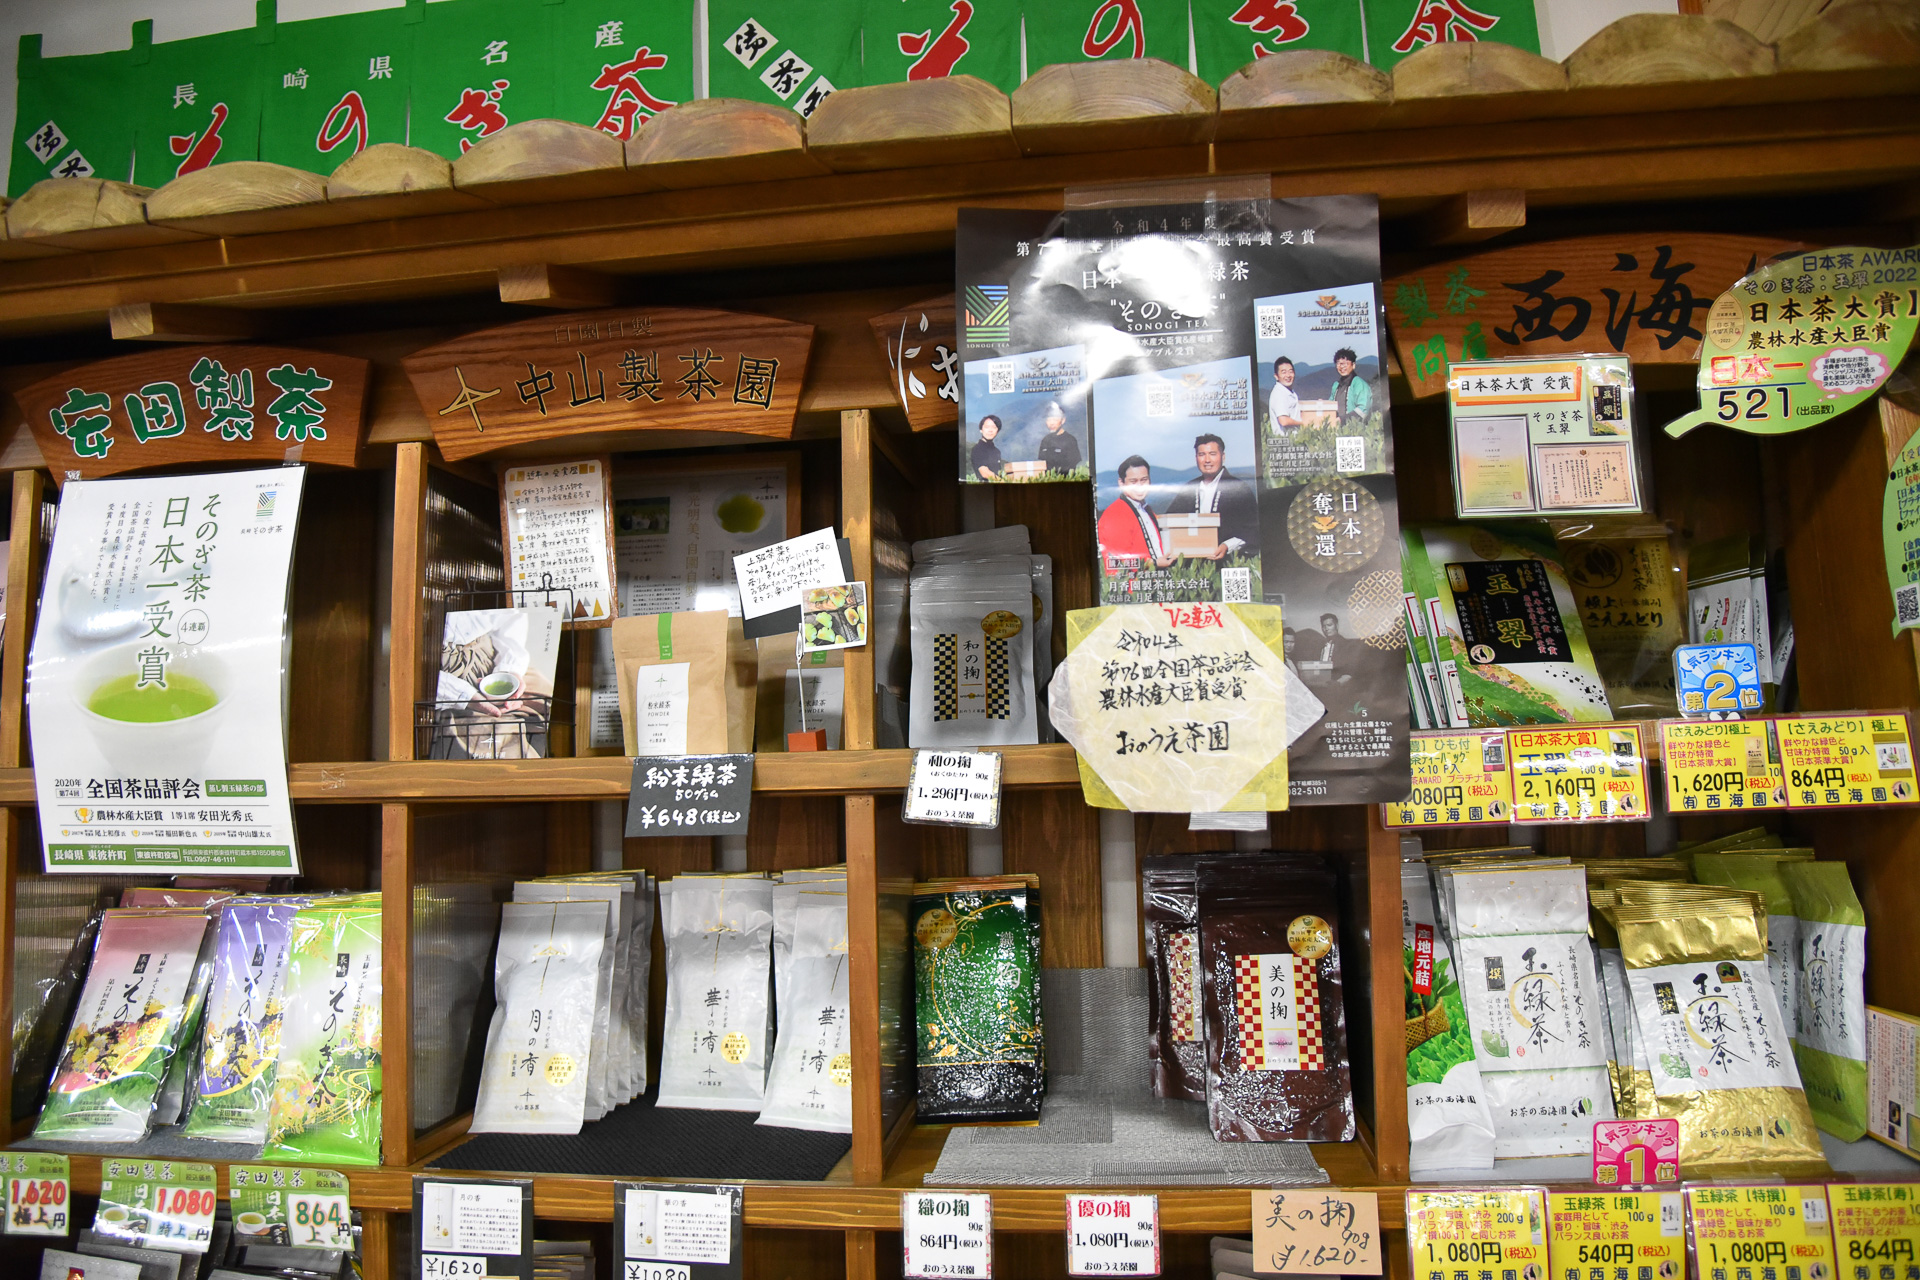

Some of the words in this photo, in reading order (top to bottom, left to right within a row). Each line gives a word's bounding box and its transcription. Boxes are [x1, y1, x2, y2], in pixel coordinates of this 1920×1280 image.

[1803, 253, 1854, 272] 日本茶
[1873, 267, 1917, 284] 2022
[1127, 322, 1179, 331] SONOGI
[1186, 320, 1209, 328] TEA
[1747, 322, 1891, 350] 農林水産大臣賞
[1710, 353, 1804, 384] 日本一
[514, 348, 780, 416] 中山製茶園
[1460, 376, 1534, 392] 日本茶大賞
[1543, 375, 1572, 390] 受賞
[50, 357, 333, 459] 安田製茶
[1718, 386, 1790, 421] 521
[1796, 404, 1835, 416] (出品数)
[1532, 409, 1584, 423] そのぎ茶
[1546, 423, 1571, 435] 玉翠
[253, 525, 283, 534] そのぎ茶
[1312, 492, 1337, 557] 奪還
[1341, 492, 1363, 556] 日本一
[182, 493, 222, 603] そのぎ茶
[137, 496, 190, 688] 日本一受賞
[1108, 579, 1210, 592] 月香園製茶株式会社
[1163, 605, 1224, 629] V2達成
[1486, 573, 1534, 649] 玉翠
[1544, 597, 1562, 634] そのぎ茶
[1585, 611, 1664, 628] さえみどり
[1115, 629, 1184, 653] 令和4年
[963, 640, 980, 680] 和の掬
[1101, 651, 1264, 686] 第76回全国茶品評会
[1678, 648, 1757, 679] 人気ランキング
[1098, 677, 1248, 713] 農林水産大臣賞受賞
[1684, 673, 1760, 711] 第2位
[1361, 709, 1368, 717] 5
[1331, 728, 1387, 736] ように管理し、新鮮
[1668, 723, 1751, 738] 【さえみどり】極上
[1787, 720, 1865, 735] 【さえみどり】
[1871, 719, 1899, 732] 極上
[1116, 721, 1230, 755] おのうえ茶園
[1325, 735, 1393, 744] なうちにじっくり丁寧に
[1434, 738, 1470, 750] ひも付
[1513, 731, 1598, 748] 【日本茶大賞】
[1668, 738, 1731, 749] 鮮やかな緑色と
[1784, 737, 1847, 748] 鮮やかな緑色と
[928, 754, 972, 769] 和の掬
[1331, 750, 1390, 758] のお茶が出来上がる。
[1669, 749, 1714, 759] 甘味が特徴
[1785, 746, 1831, 757] 甘味が特徴
[1791, 756, 1855, 767] 【日本茶準大賞】
[1519, 752, 1568, 777] 玉翠
[1674, 757, 1738, 768] 【日本茶準大賞】
[55, 778, 82, 788] 2020年
[643, 763, 738, 790] 粉末緑茶
[975, 772, 989, 780] 90g
[1447, 773, 1493, 784] プラチナ賞
[1672, 772, 1744, 794] 1,620円
[1745, 777, 1776, 790] (税込)
[1791, 767, 1845, 788] 864円
[1846, 773, 1873, 783] (税込)
[86, 778, 201, 800] 全国茶品評会
[1468, 785, 1498, 797] (税込)
[1523, 777, 1596, 799] 2,160円
[1603, 780, 1636, 793] (税込)
[96, 810, 164, 822] 農林水産大臣賞
[198, 810, 242, 822] 安田光秀
[244, 812, 254, 822] 氏
[925, 809, 975, 820] おのうえ茶園
[54, 849, 84, 861] 長崎県
[1414, 930, 1432, 988] 産地元詰
[1568, 945, 1580, 989] 長崎県名産
[1269, 964, 1288, 1020] 美の掬
[1514, 946, 1565, 1054] 玉緑茶
[1742, 970, 1761, 1011] 長崎県名産
[701, 986, 722, 1054] 華の香
[1573, 991, 1591, 1049] そのぎ茶
[1687, 972, 1751, 1074] 玉緑茶
[307, 981, 348, 1108] そのぎ茶
[520, 1008, 542, 1077] 月の香
[808, 1005, 837, 1074] 華の香
[1753, 1012, 1781, 1069] そのぎ茶
[1415, 1095, 1477, 1106] お茶の西海園
[1510, 1106, 1568, 1117] お茶の西海園
[1595, 1123, 1678, 1152] 人気ランキング
[1699, 1127, 1763, 1139] お茶の西海園
[107, 1160, 176, 1181] 安田製茶
[1596, 1146, 1677, 1184] 第1位
[235, 1167, 306, 1187] 安田製茶
[11, 1179, 67, 1205] 1,620
[157, 1187, 215, 1216] 1,080
[459, 1193, 482, 1202] 月の香
[917, 1198, 970, 1217] 織の掬
[1078, 1199, 1131, 1218] 優の掬
[1265, 1194, 1355, 1231] 美の掬
[1563, 1196, 1642, 1212] 玉緑茶【撰】
[13, 1206, 49, 1226] 極上
[53, 1212, 66, 1228] 円
[296, 1200, 342, 1227] 864
[337, 1222, 351, 1238] 円
[967, 1222, 984, 1232] 90g
[1137, 1221, 1153, 1231] 90g
[1554, 1211, 1609, 1222] 家庭用として
[196, 1226, 209, 1242] 円
[1341, 1227, 1370, 1250] 90g
[1554, 1230, 1629, 1241] バランス良いお茶
[1698, 1228, 1765, 1239] 深みのあるお茶
[1427, 1241, 1502, 1265] 1,080円
[1504, 1245, 1538, 1259] (税込)
[1578, 1242, 1634, 1265] 540円
[1637, 1245, 1671, 1258] (税込)
[1709, 1241, 1787, 1265] 1,080円
[1791, 1245, 1825, 1257] (税込)
[1849, 1238, 1915, 1261] 864円
[425, 1258, 483, 1278] ¥1,620
[922, 1264, 975, 1275] おのうえ茶園
[1084, 1261, 1138, 1272] おのうえ茶園
